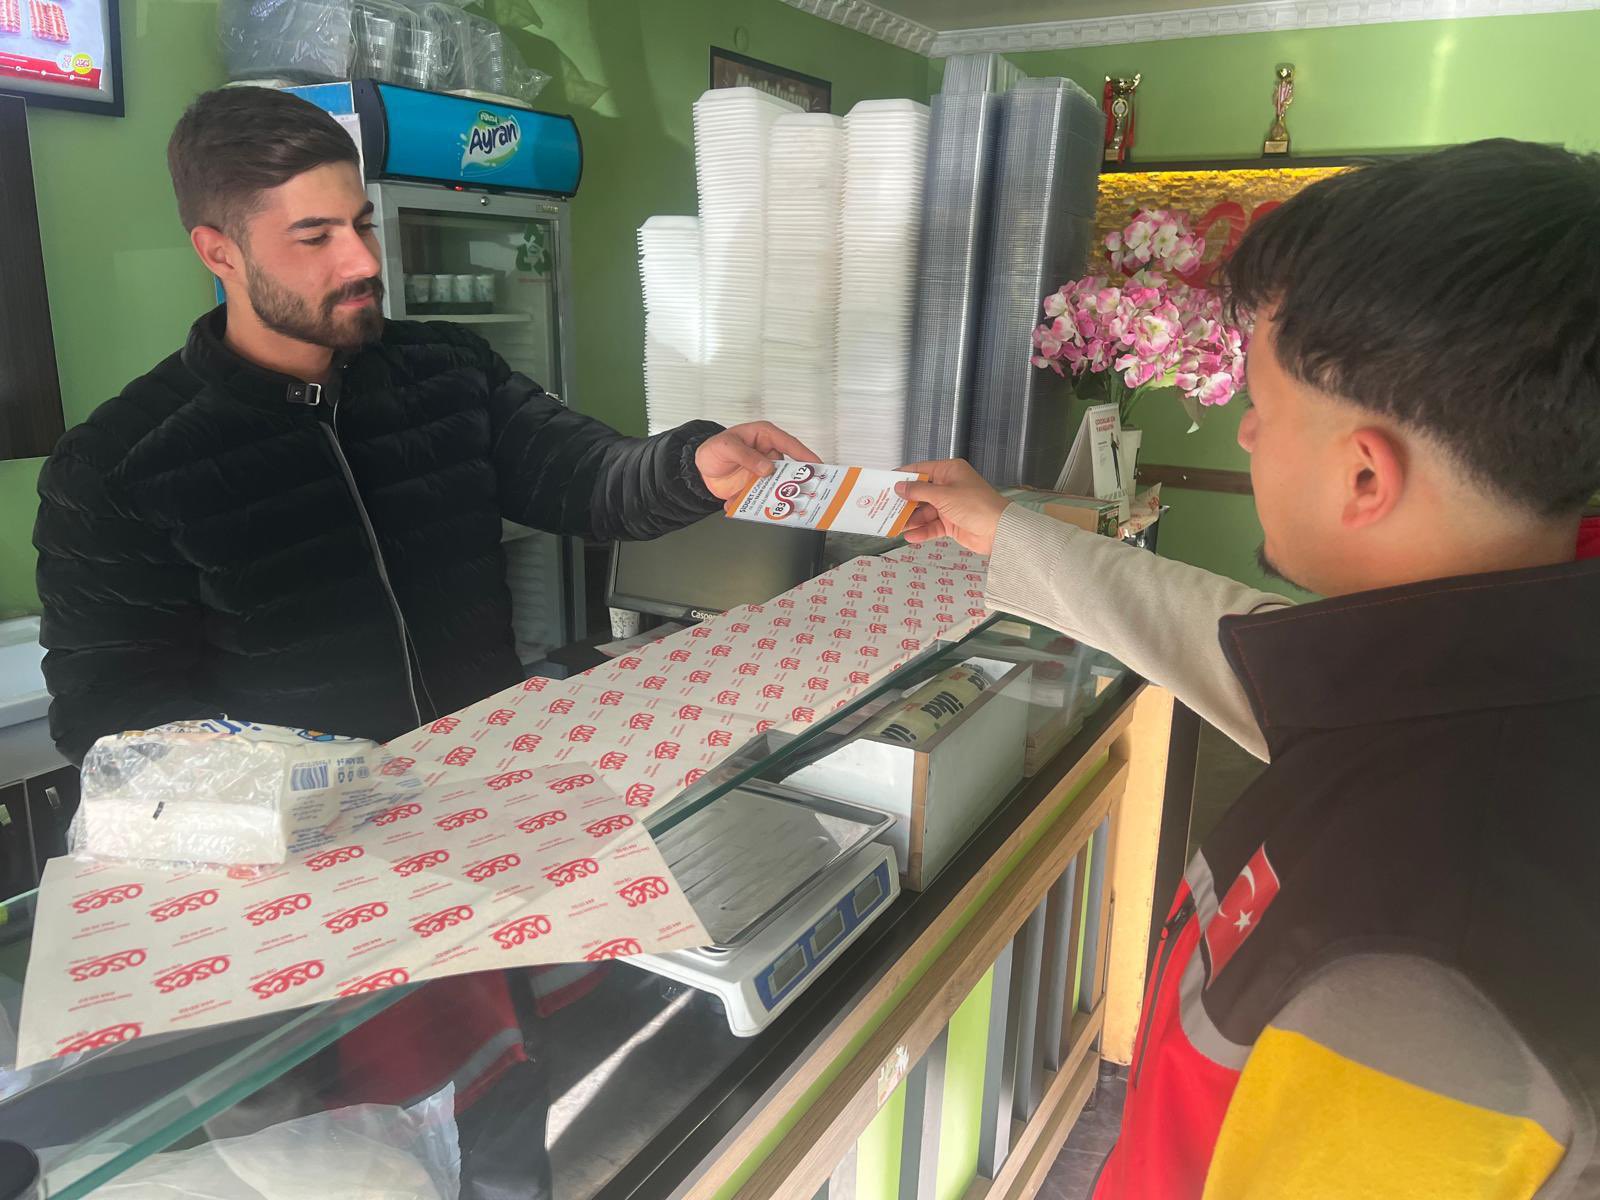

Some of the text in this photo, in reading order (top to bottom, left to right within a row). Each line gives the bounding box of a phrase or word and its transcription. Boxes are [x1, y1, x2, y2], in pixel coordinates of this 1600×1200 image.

[469, 123, 518, 155] Ayran
[793, 464, 807, 480] 112
[772, 502, 786, 517] 183
